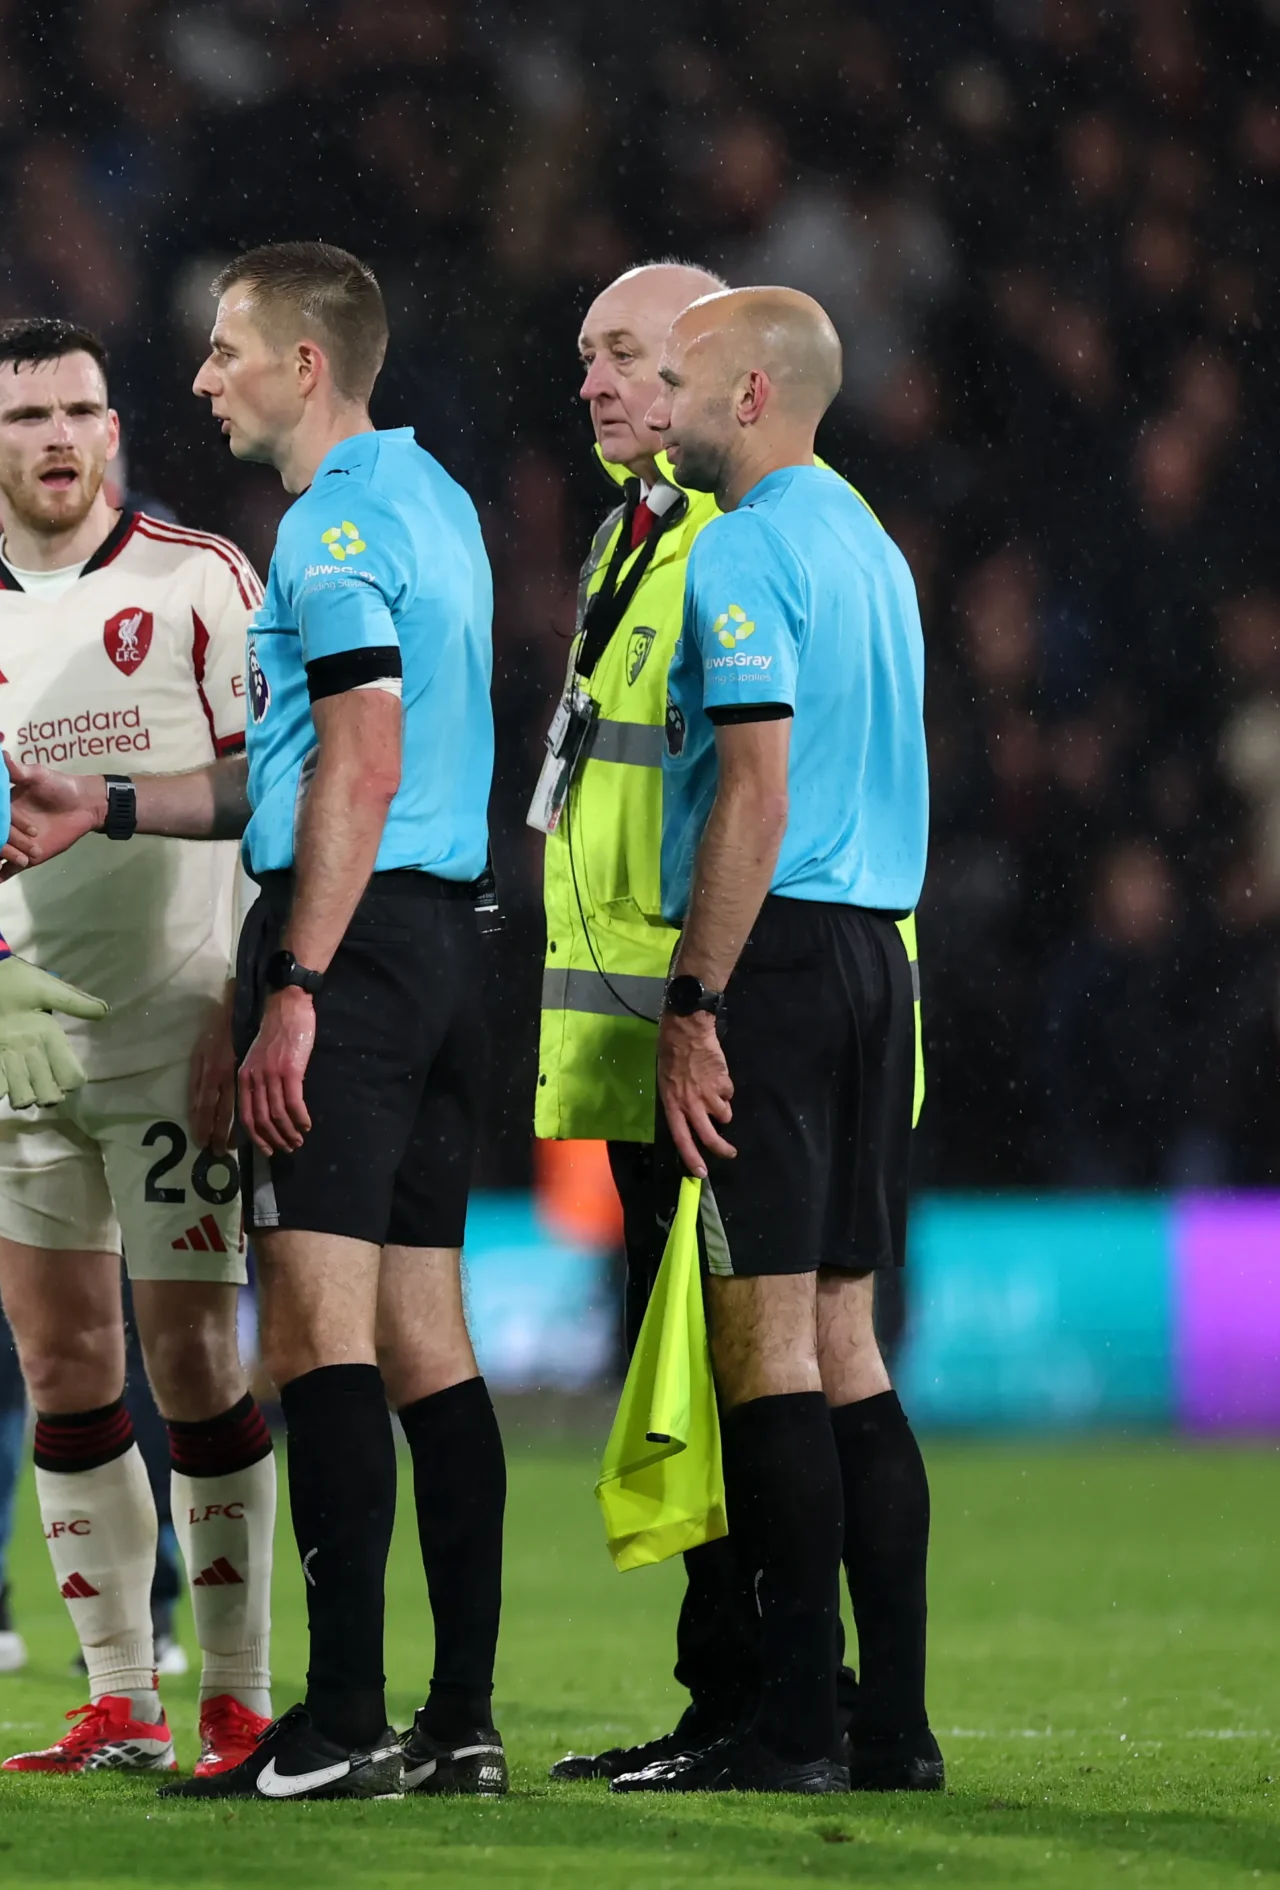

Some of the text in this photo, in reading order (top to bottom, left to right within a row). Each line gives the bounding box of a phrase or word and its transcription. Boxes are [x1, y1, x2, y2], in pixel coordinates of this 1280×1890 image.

[706, 652, 773, 670] uwsGray
[17, 705, 140, 745] standard
[21, 728, 151, 764] chartered
[141, 1121, 240, 1205] 26
[188, 1502, 245, 1525] LFC
[478, 1766, 503, 1781] NIKE
